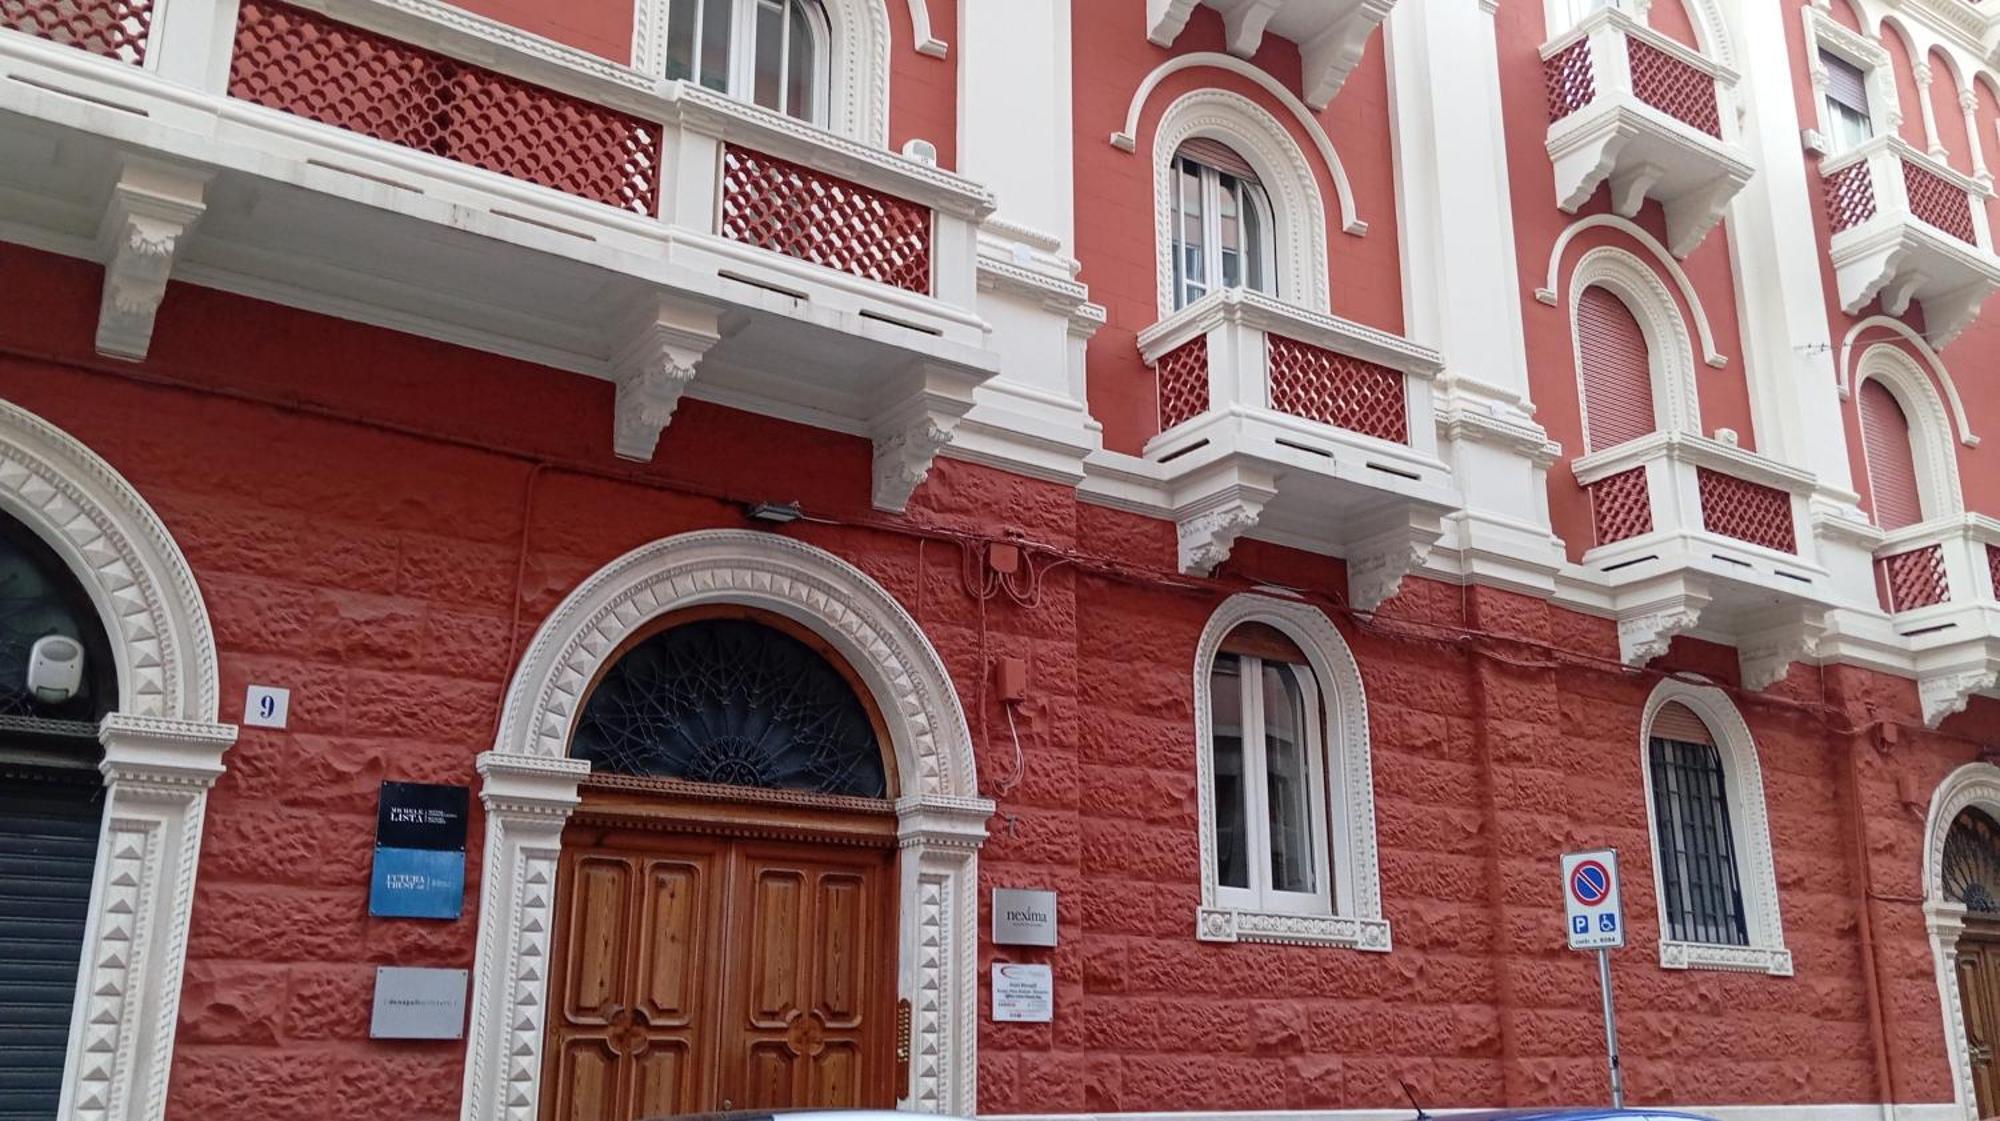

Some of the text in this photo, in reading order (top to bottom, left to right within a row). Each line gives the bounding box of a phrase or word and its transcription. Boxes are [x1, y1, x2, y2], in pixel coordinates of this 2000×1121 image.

[260, 694, 275, 719] 9
[390, 812, 424, 823] LISTA
[1007, 905, 1048, 923] nexima
[1576, 917, 1586, 933] P
